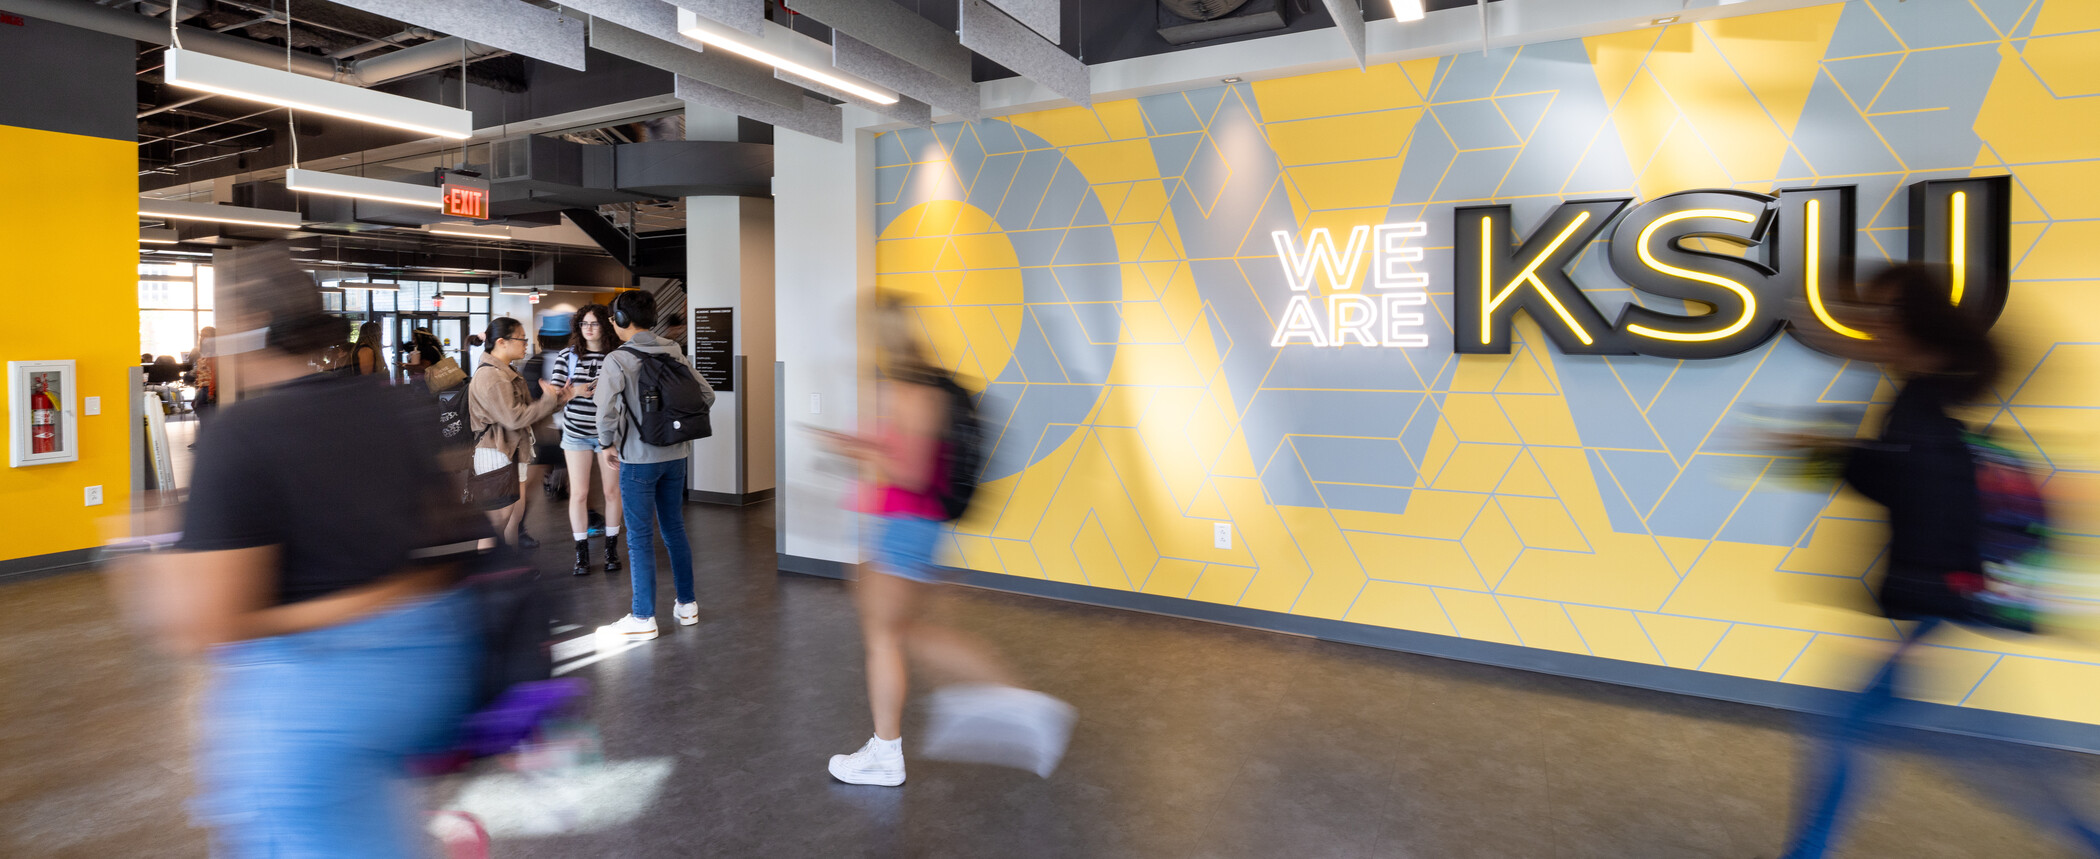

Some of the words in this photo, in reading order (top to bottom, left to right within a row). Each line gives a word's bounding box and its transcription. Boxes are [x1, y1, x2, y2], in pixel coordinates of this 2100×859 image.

[451, 188, 482, 216] EXIT
[1271, 221, 1429, 291] WE
[1454, 174, 2012, 361] KSU
[1270, 292, 1429, 347] ARE
